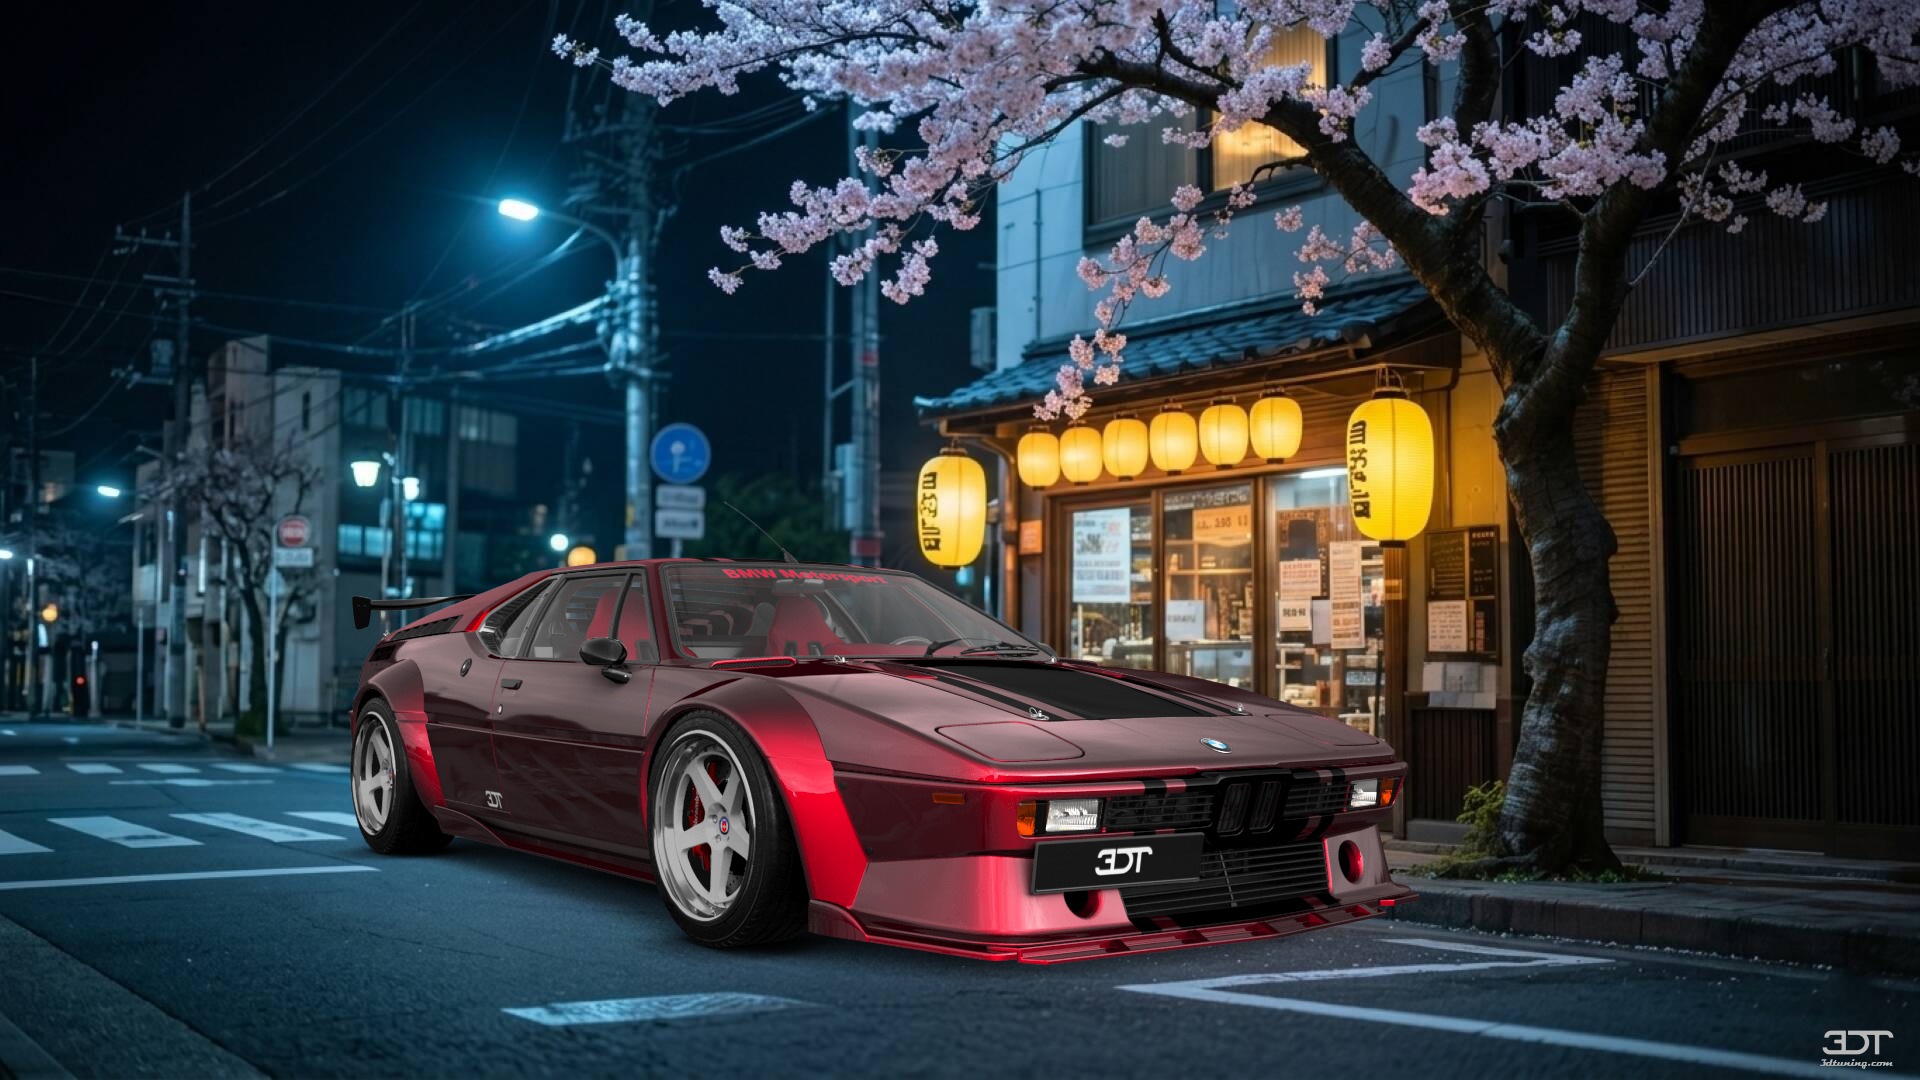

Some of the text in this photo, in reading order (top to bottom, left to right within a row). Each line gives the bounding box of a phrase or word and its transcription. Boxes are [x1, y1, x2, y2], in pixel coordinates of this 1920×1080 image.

[722, 569, 888, 584] BMW Motorsport
[1095, 846, 1153, 876] 3DT
